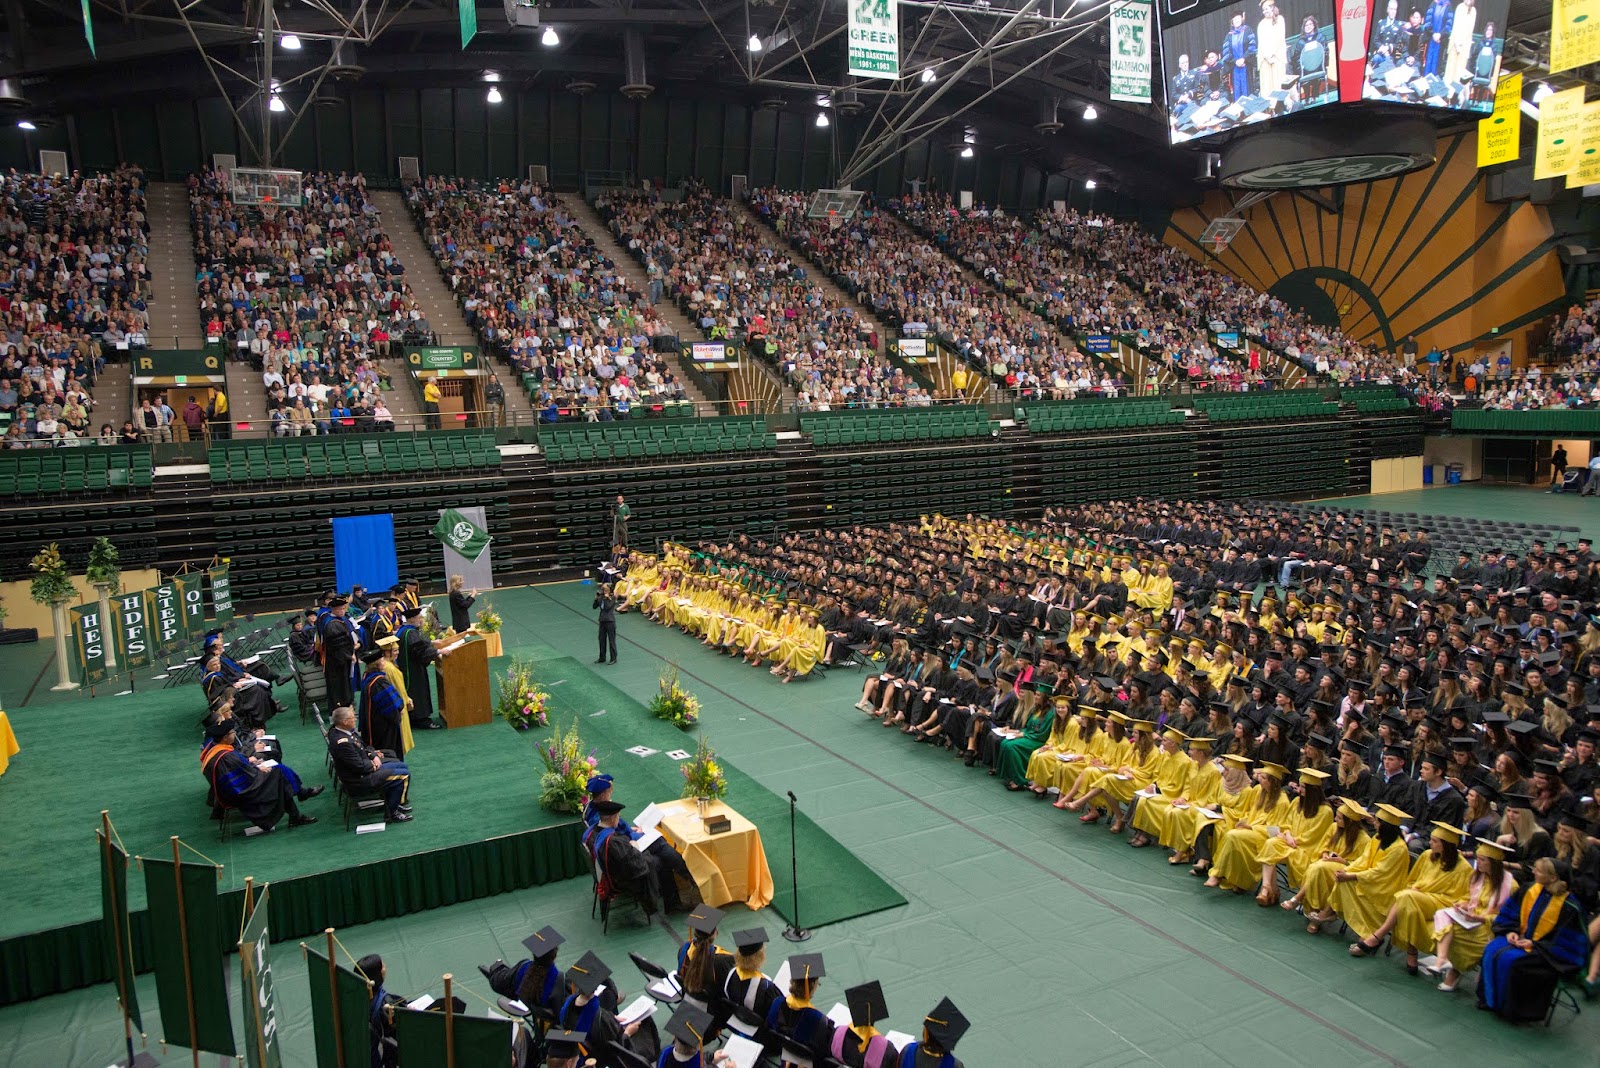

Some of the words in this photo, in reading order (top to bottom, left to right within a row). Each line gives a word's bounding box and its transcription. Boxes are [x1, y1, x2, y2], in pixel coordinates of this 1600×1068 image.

[1114, 7, 1147, 20] BECKY
[850, 28, 897, 44] GREEN
[1559, 22, 1600, 41] Volleyba
[1118, 25, 1145, 57] 25
[1112, 60, 1150, 73] HAMMON
[1487, 137, 1510, 148] Softball
[1490, 149, 1506, 159] 2003
[1546, 146, 1570, 159] Softball
[1551, 159, 1565, 169] 1997
[726, 346, 736, 357] O
[927, 342, 935, 352] N
[140, 357, 153, 370] R
[205, 356, 218, 369] Q
[409, 353, 421, 365] Q
[463, 352, 474, 363] P
[186, 590, 201, 616] OT
[157, 586, 178, 641] STEPP
[122, 595, 146, 655] HDFS
[82, 613, 103, 660] HES
